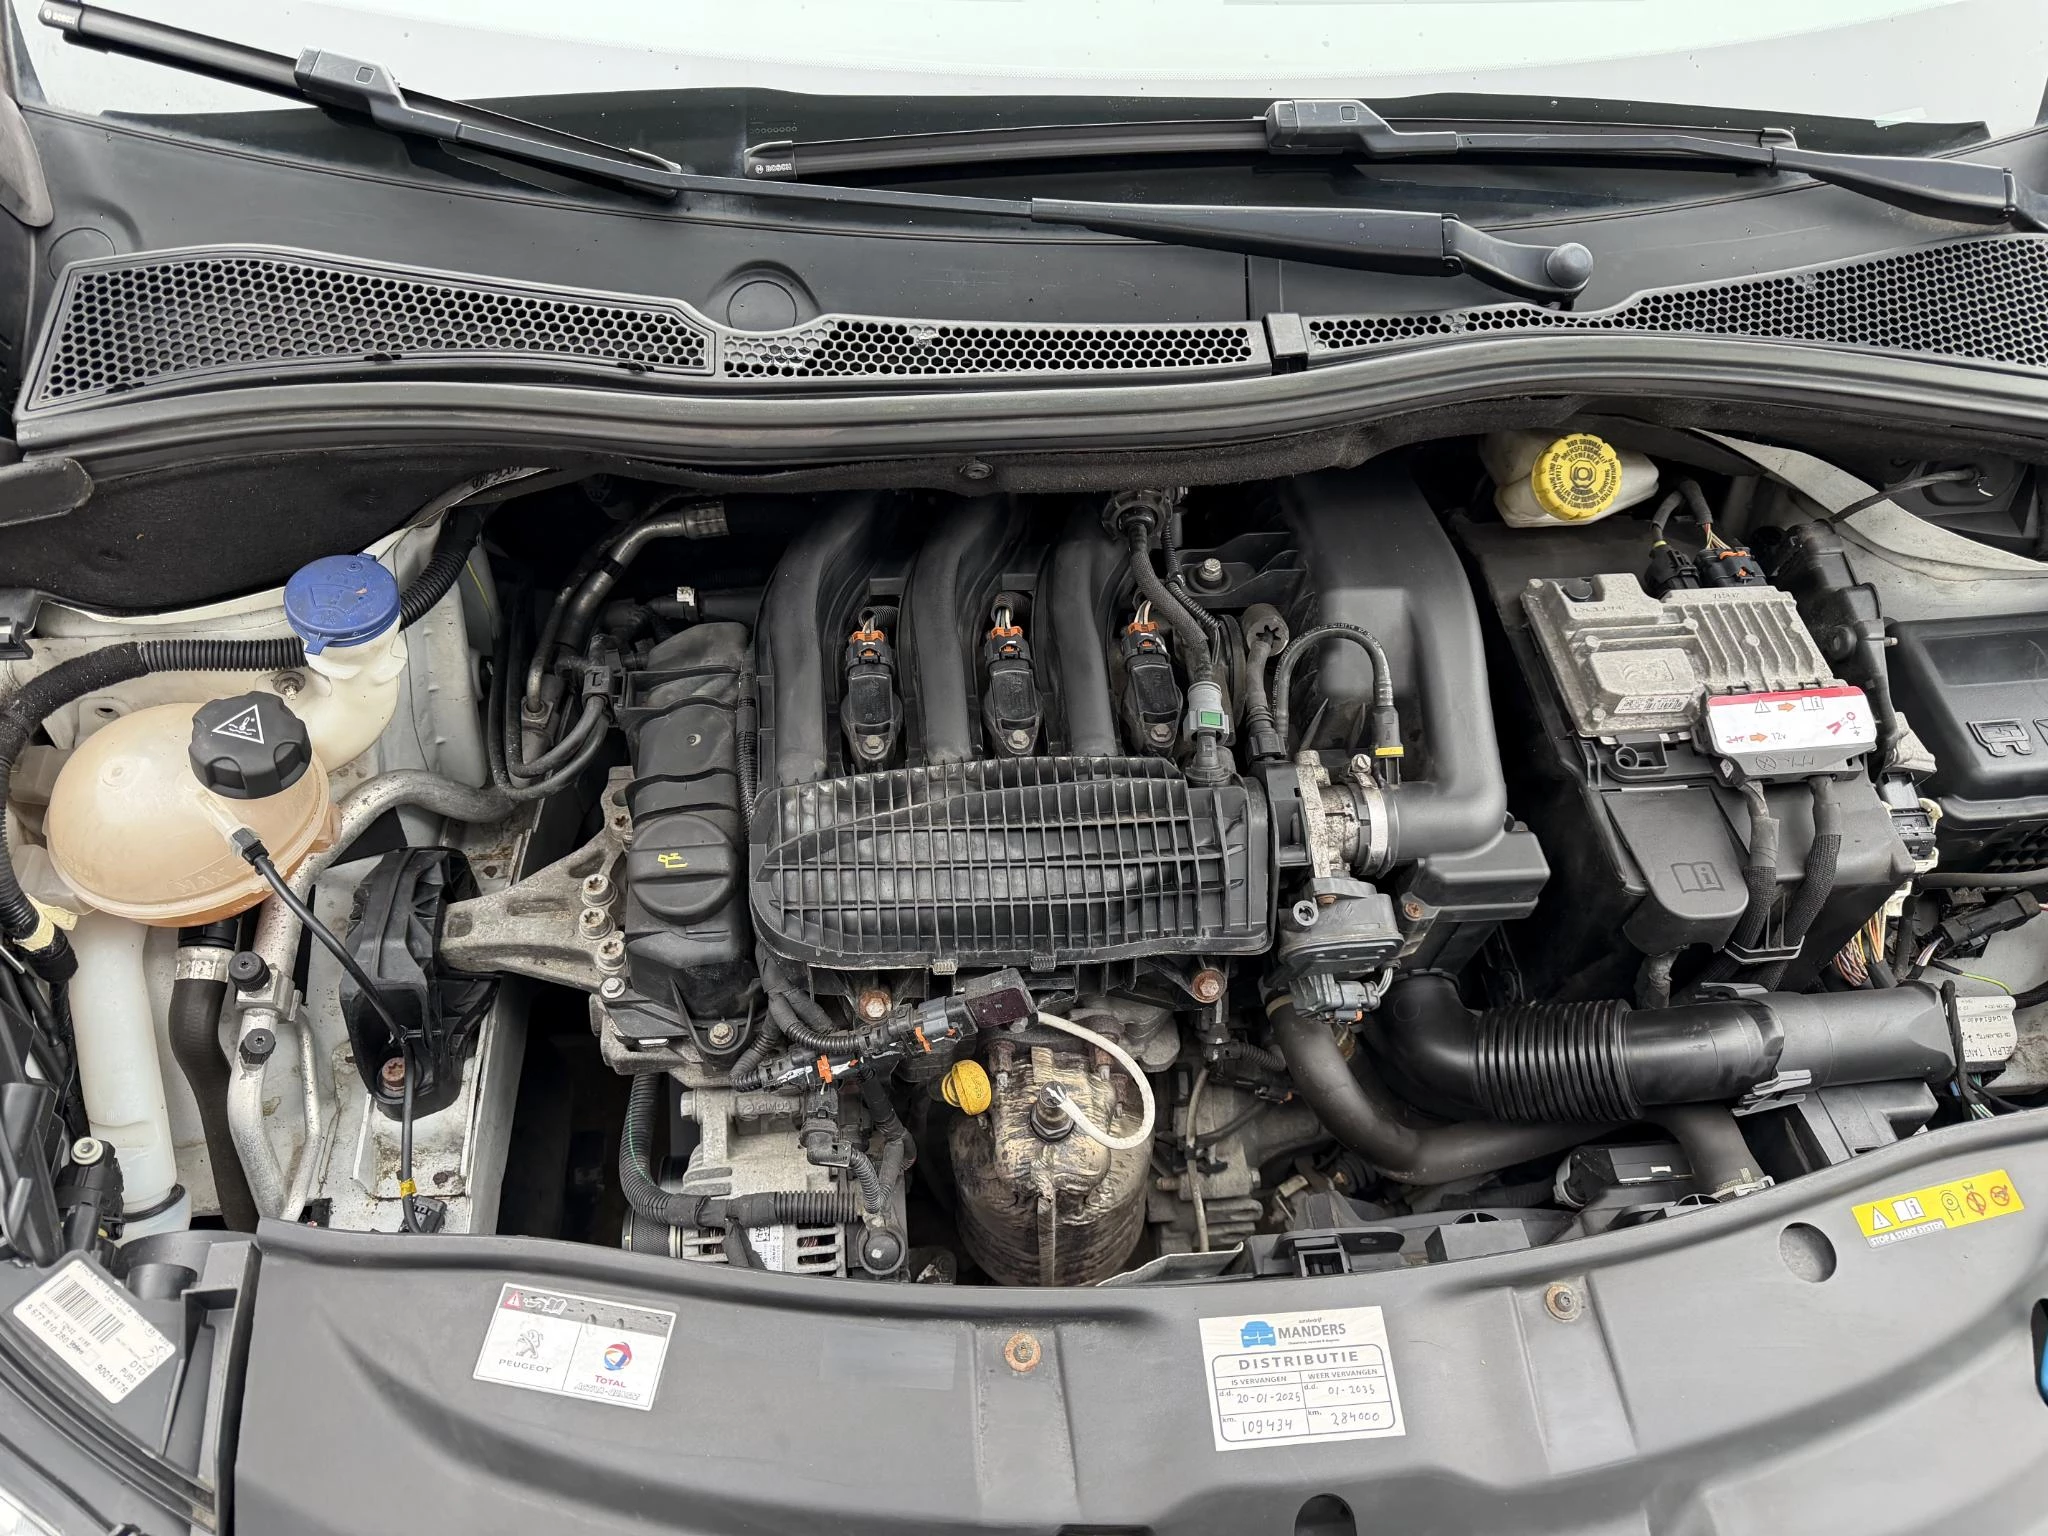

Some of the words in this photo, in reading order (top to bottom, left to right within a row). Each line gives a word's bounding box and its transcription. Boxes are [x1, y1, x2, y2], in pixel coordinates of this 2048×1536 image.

[765, 163, 792, 172] BOSCH
[1870, 1234, 1889, 1246] STOP
[1896, 1227, 1918, 1240] START
[1918, 1221, 1945, 1234] SYSTEM
[1278, 1323, 1346, 1339] MANDERS
[499, 1359, 552, 1374] PEUGEOT
[1238, 1351, 1359, 1370] DISTRIBUTIE
[595, 1374, 627, 1388] TOTAL
[1239, 1376, 1287, 1386] VERVANGEN
[1308, 1372, 1330, 1380] WEER
[1331, 1368, 1378, 1378] VERVANGEN
[1221, 1416, 1237, 1424] km.
[1330, 1411, 1380, 1426] 284000
[1242, 1418, 1293, 1435] 109434
